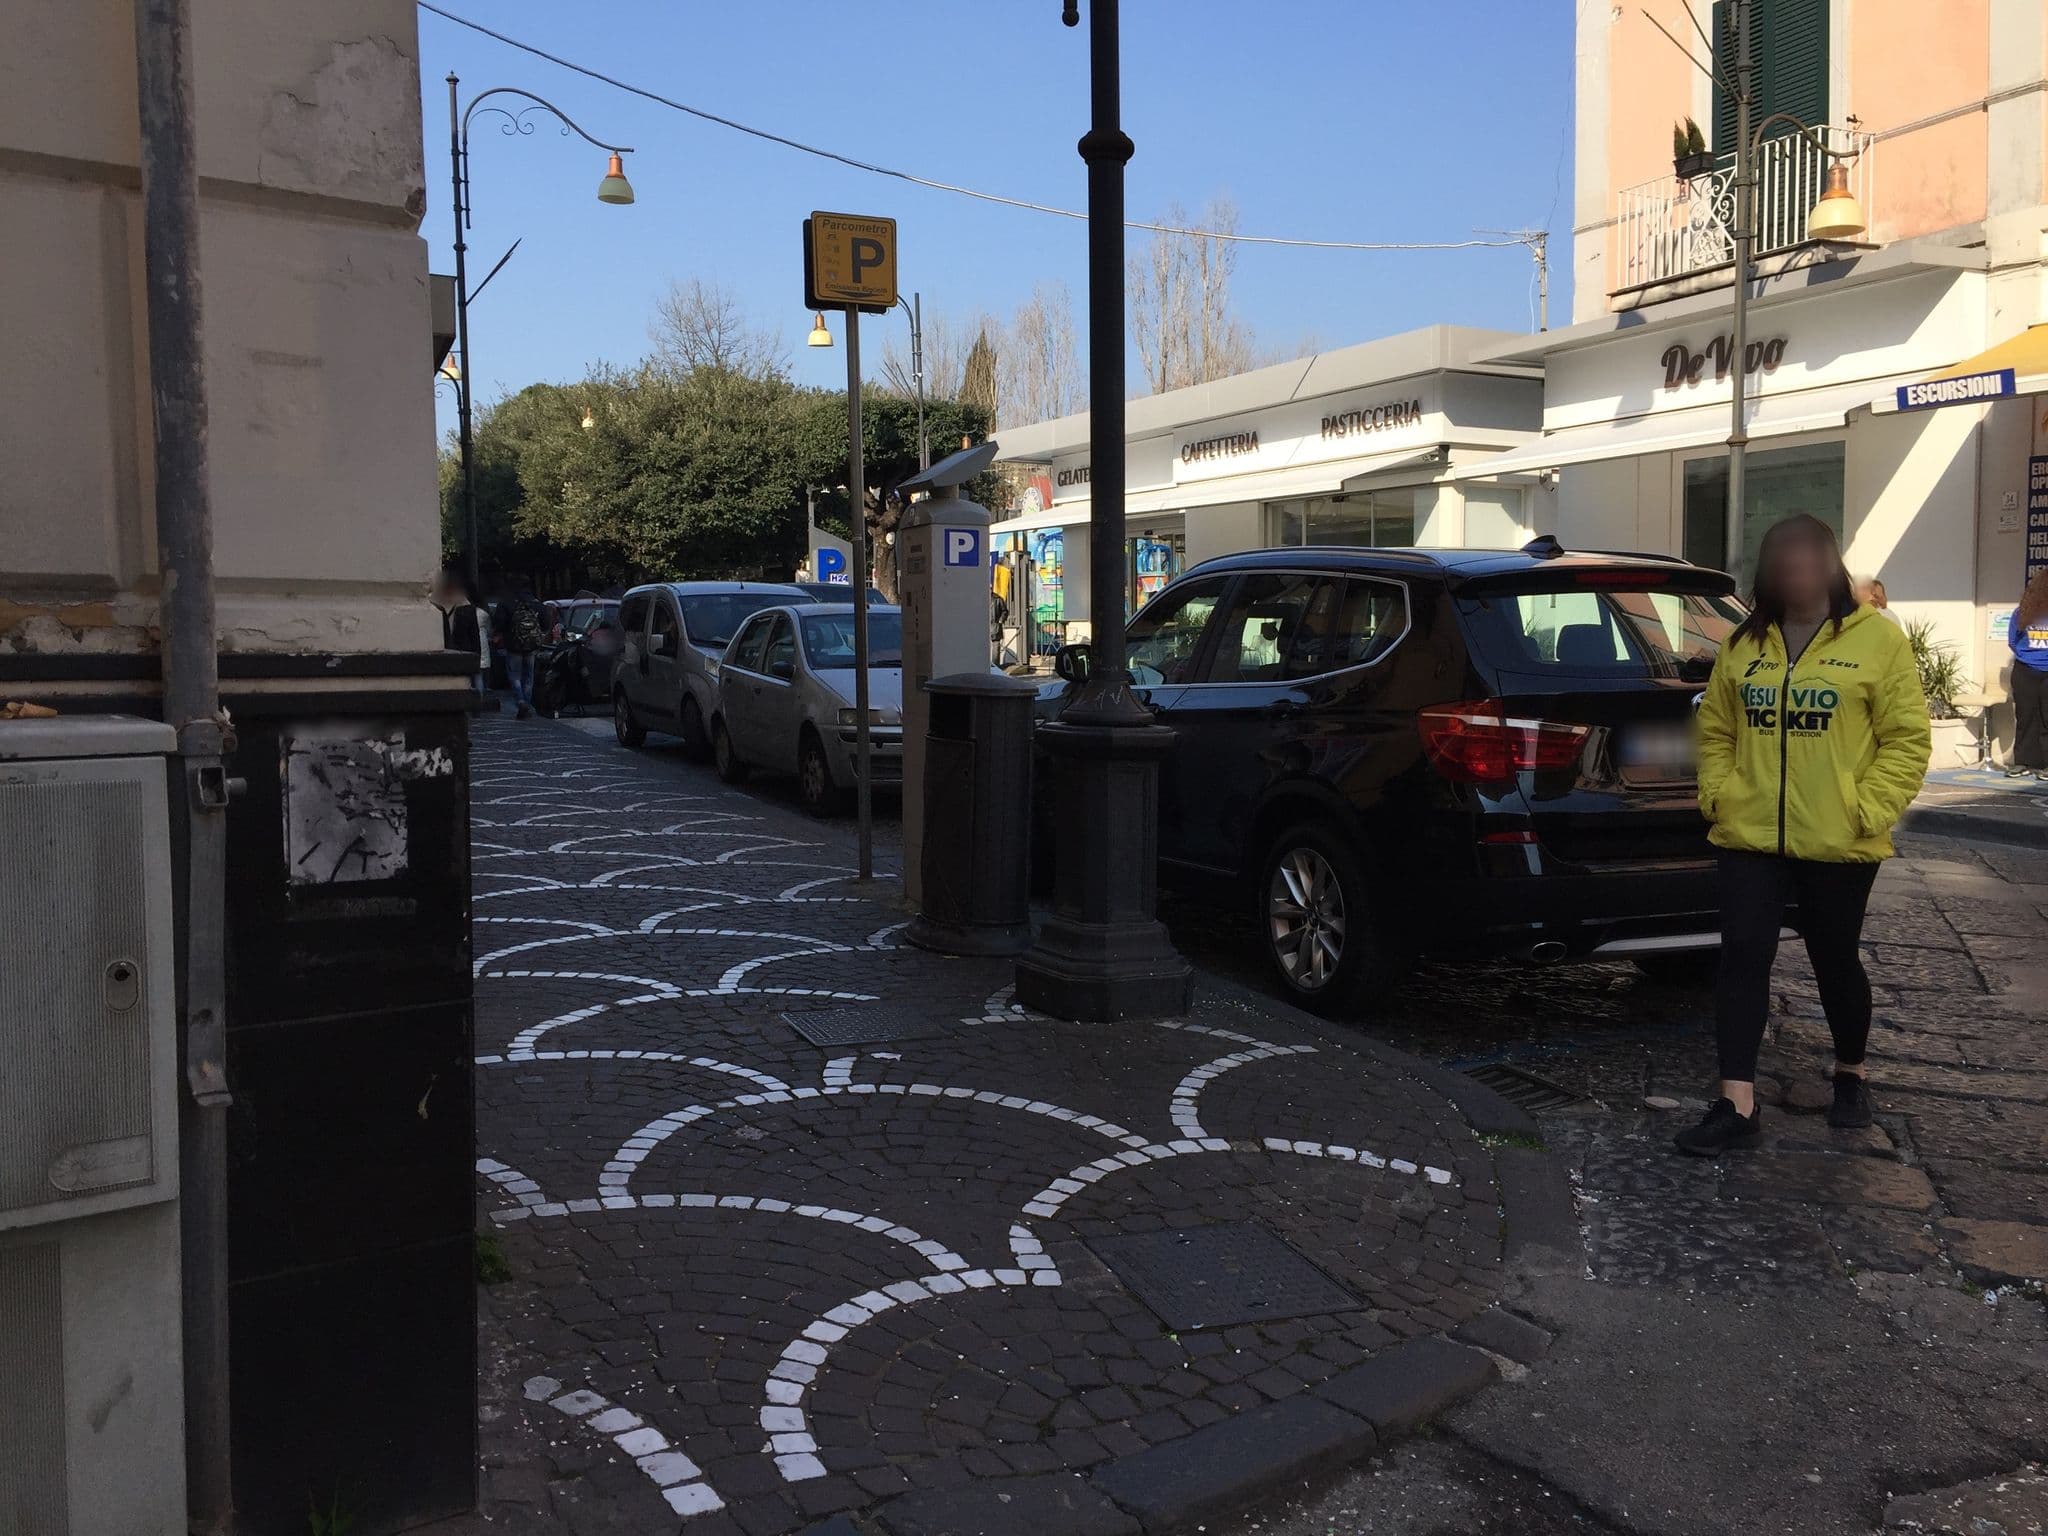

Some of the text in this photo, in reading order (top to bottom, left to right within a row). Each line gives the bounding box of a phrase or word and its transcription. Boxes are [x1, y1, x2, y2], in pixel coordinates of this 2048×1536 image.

[822, 219, 888, 234] Parcometro
[851, 238, 885, 284] P
[1661, 334, 1788, 388] De Vvo
[1907, 374, 2002, 405] ESCURSIONI
[1321, 400, 1422, 438] PASTICCERIA
[1181, 431, 1260, 463] CAFFETTERIA
[949, 532, 975, 563] P
[818, 548, 845, 583] P
[831, 574, 848, 582] H24
[1827, 658, 1860, 669] Zeus
[1790, 730, 1822, 738] STATION
